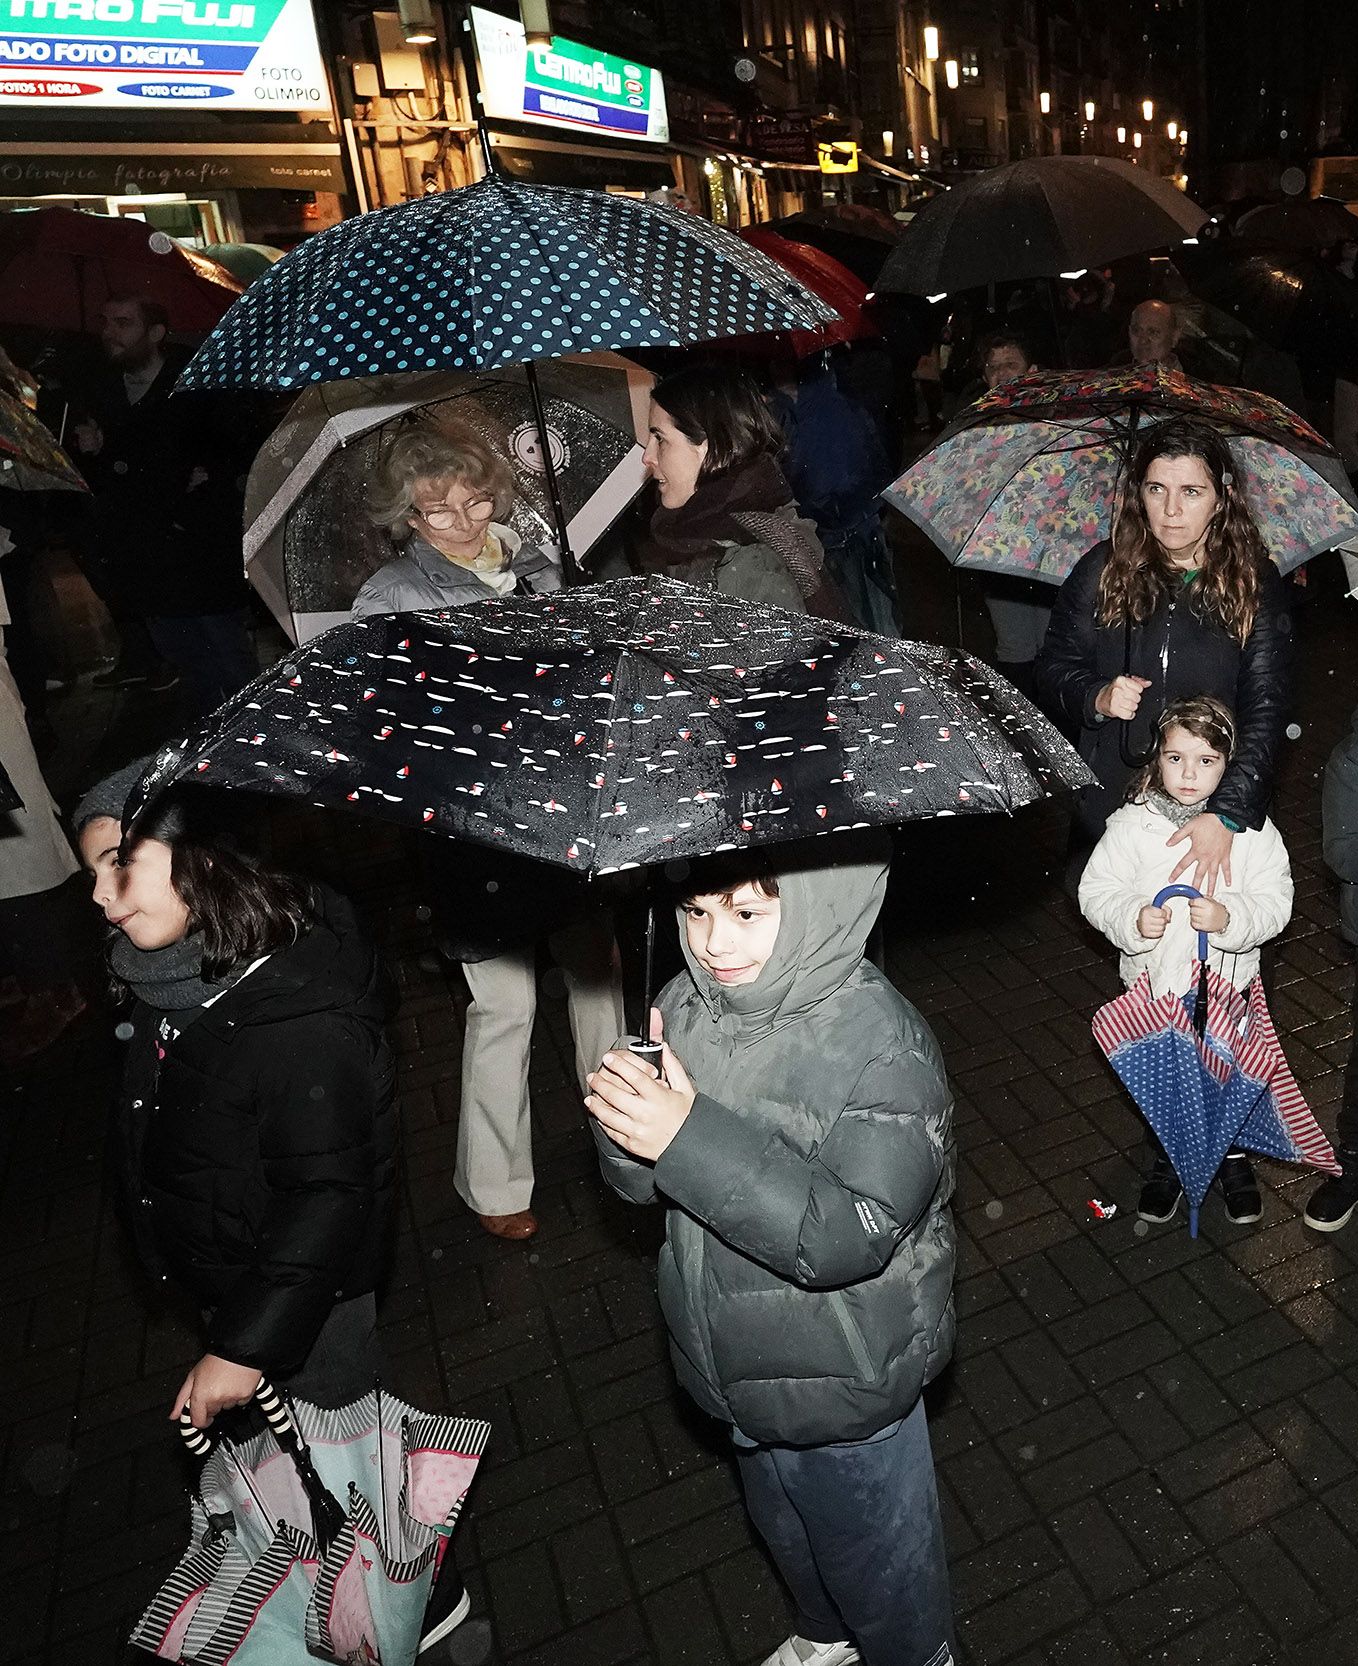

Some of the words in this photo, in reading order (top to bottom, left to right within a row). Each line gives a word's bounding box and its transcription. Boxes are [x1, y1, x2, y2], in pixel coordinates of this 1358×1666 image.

[54, 42, 116, 64] FOTO
[120, 45, 205, 66] DIGITAL
[261, 67, 303, 82] FOTO
[37, 82, 46, 94] 1
[46, 83, 82, 95] HORA
[141, 85, 170, 97] FOTO
[170, 86, 212, 97] CARNET
[254, 86, 321, 101] OLIMPIO
